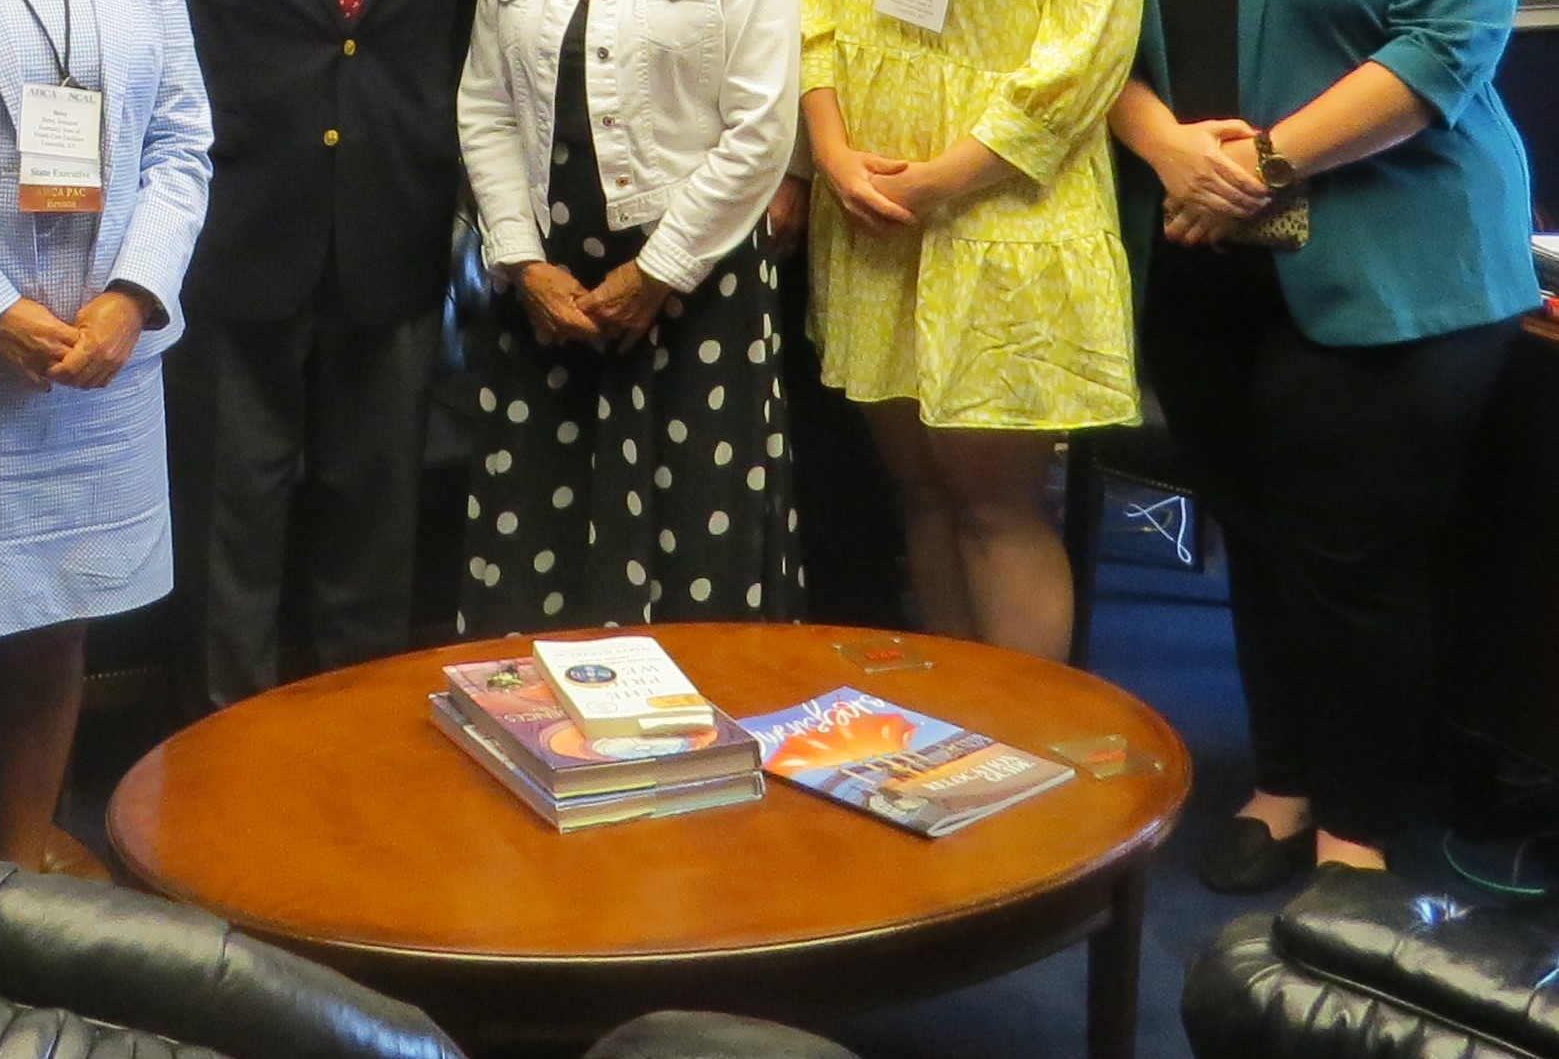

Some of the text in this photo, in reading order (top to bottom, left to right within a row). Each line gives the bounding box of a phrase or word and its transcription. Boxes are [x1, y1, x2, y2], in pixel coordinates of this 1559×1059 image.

[67, 92, 97, 104] NCAL
[30, 167, 51, 177] State
[66, 187, 87, 197] PAC
